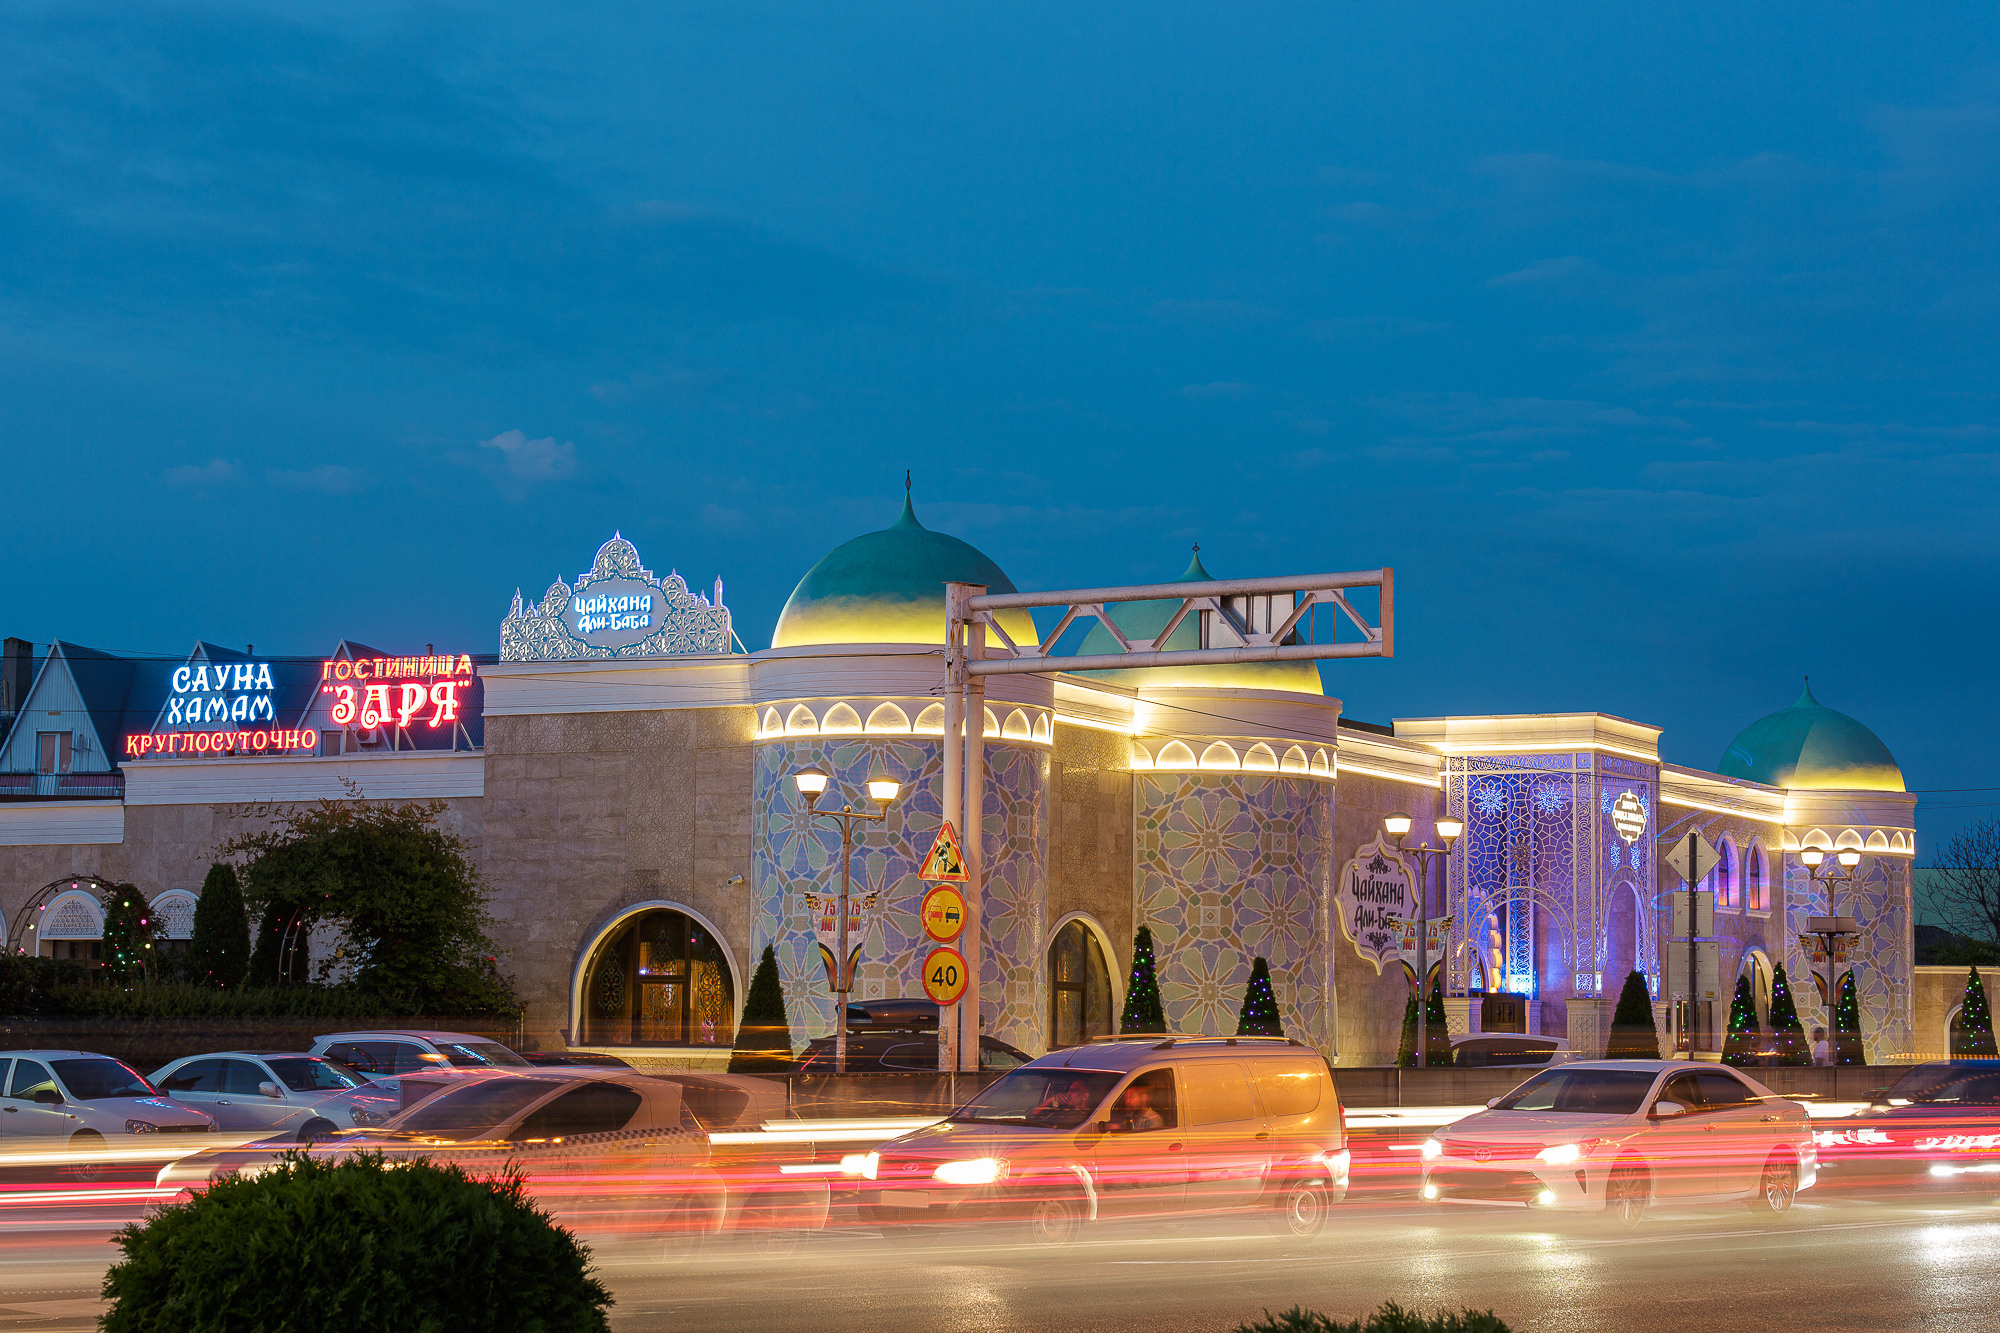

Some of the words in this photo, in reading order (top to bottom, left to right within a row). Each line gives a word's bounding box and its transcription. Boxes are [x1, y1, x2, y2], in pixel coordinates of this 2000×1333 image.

[172, 663, 274, 693] САУНА
[322, 654, 471, 680] ГОСТИНИЦА
[167, 695, 273, 724] ХАМАМ
[126, 729, 317, 756] КРУГЛОСУТОЧНО
[823, 898, 836, 915] 75
[850, 898, 861, 915] 75
[1404, 922, 1416, 937] 75
[1428, 922, 1437, 937] 75
[931, 965, 957, 987] 40
